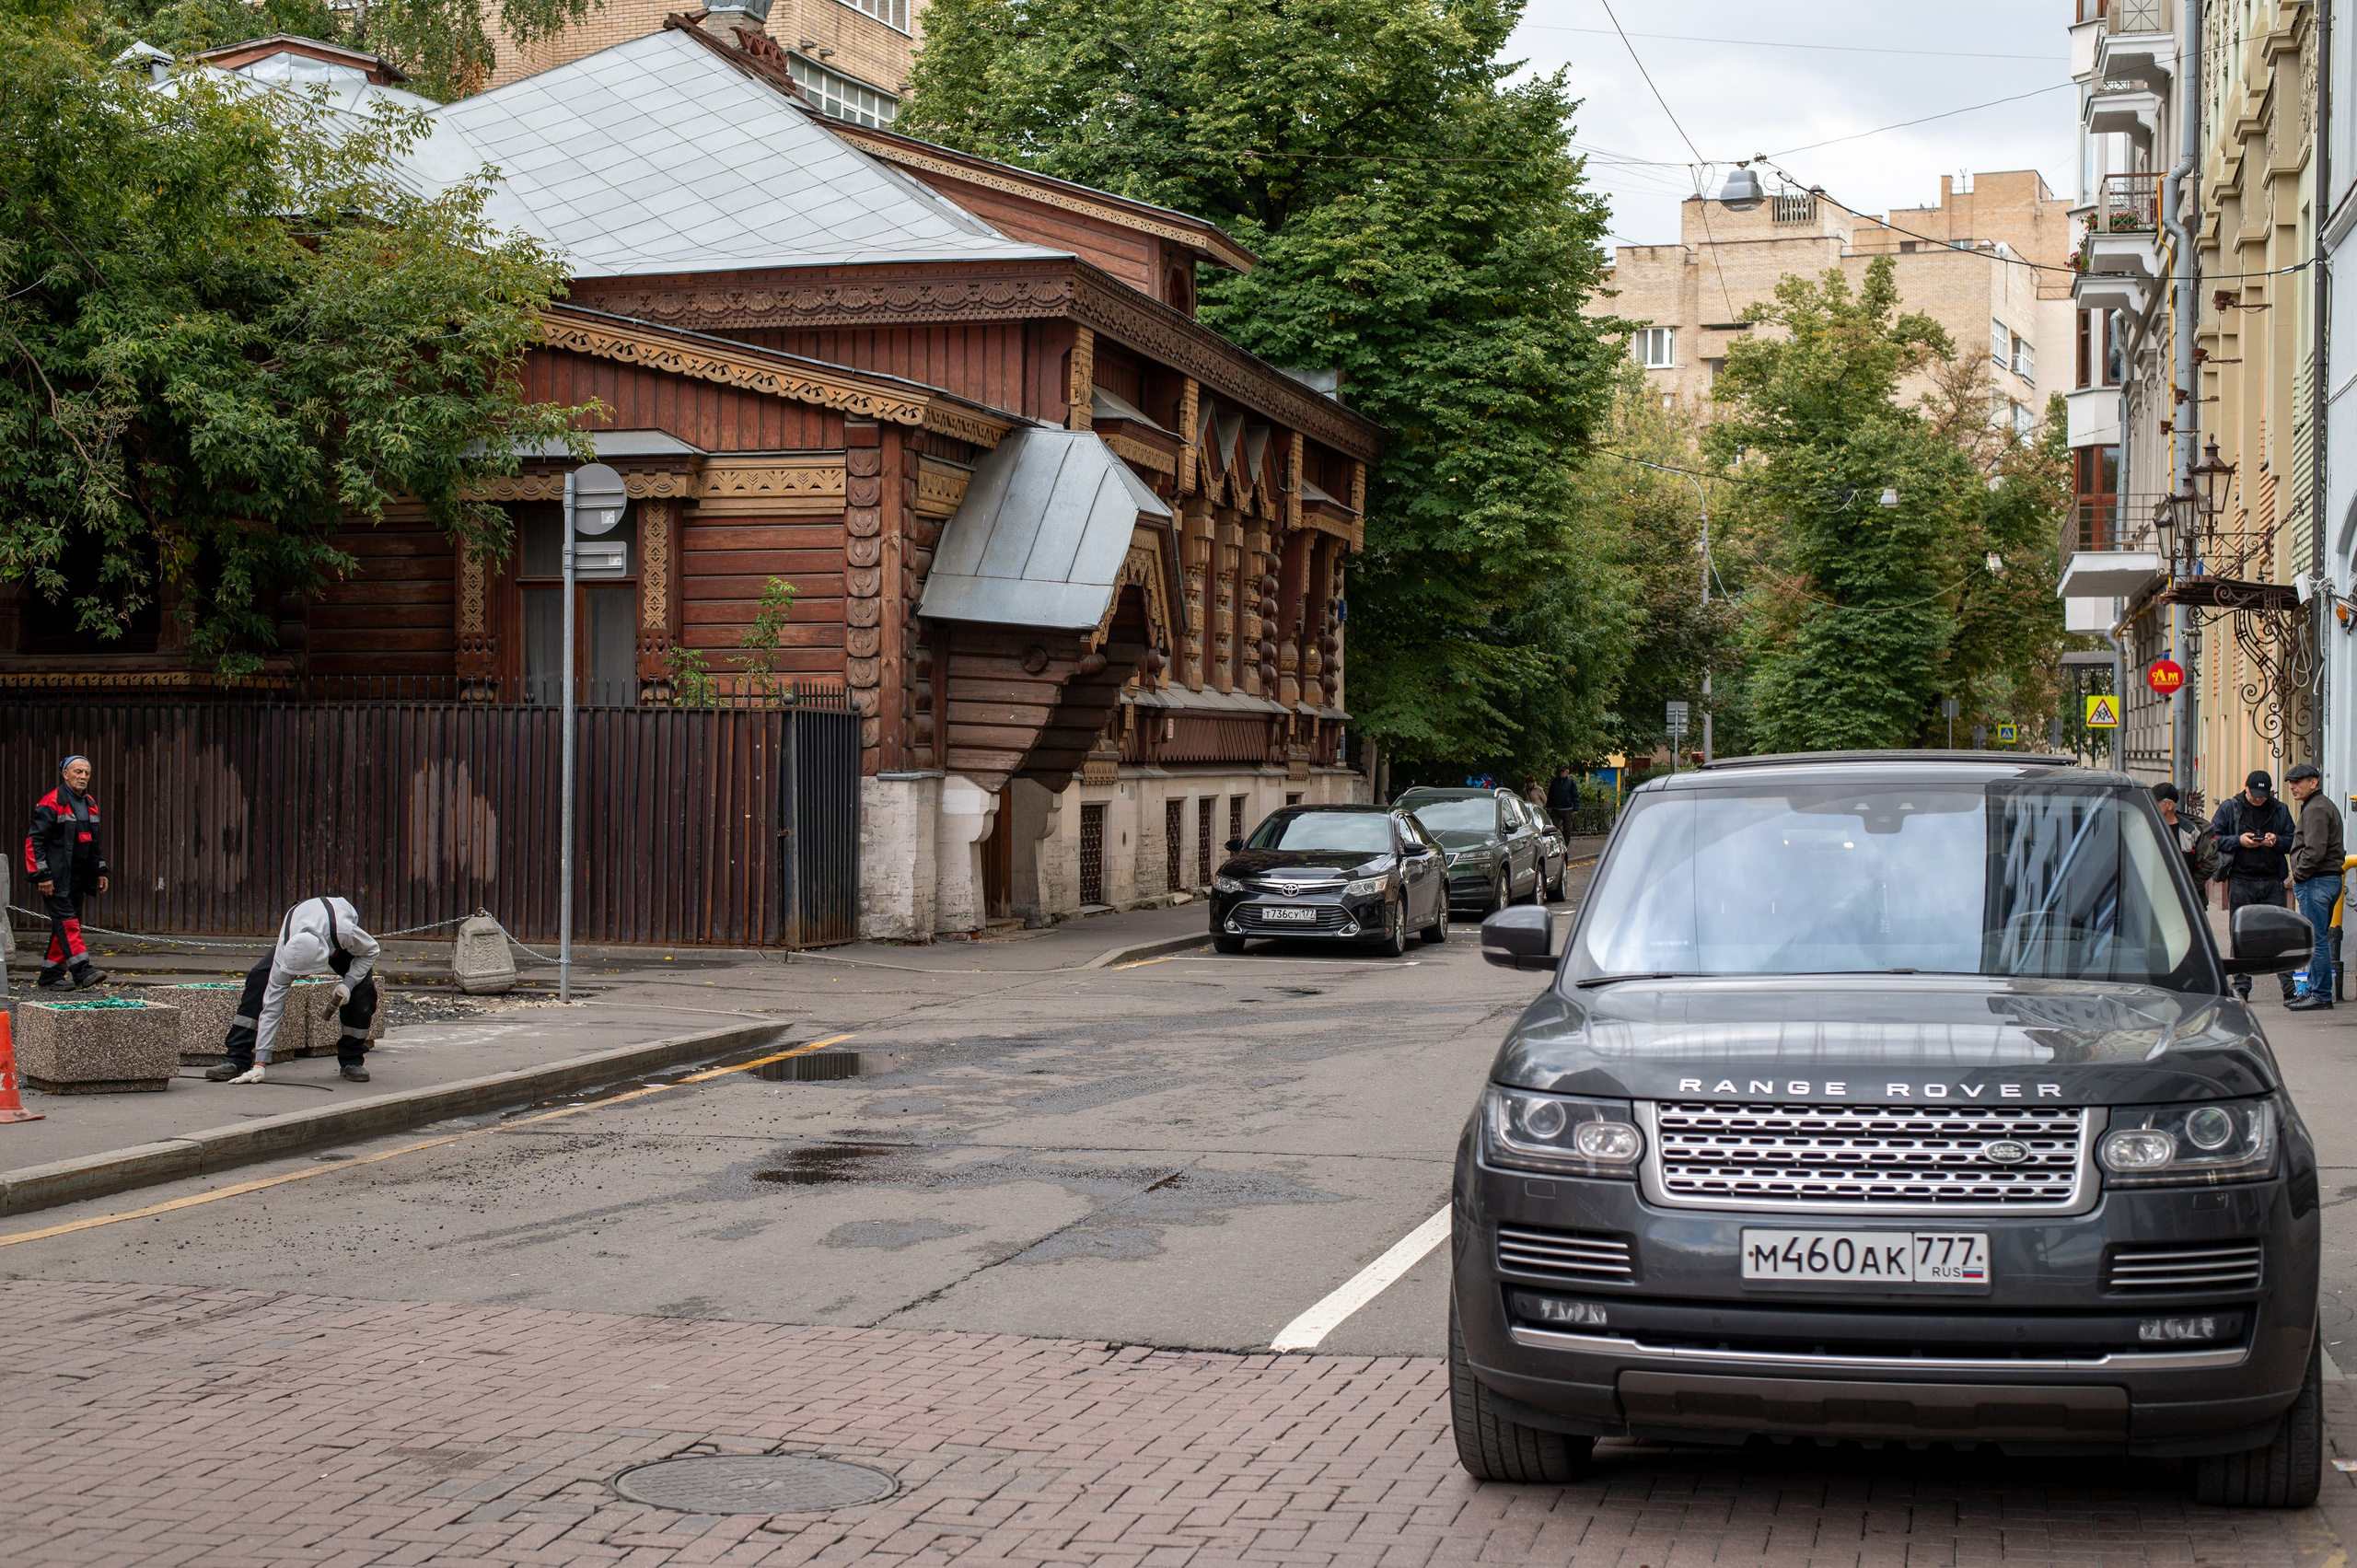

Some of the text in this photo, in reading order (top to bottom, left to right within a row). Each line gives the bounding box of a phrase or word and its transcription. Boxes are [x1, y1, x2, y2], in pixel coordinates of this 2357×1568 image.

[1266, 910, 1299, 919] Т736СУ
[1678, 1078, 2063, 1098] RANGE ROVER
[1754, 1237, 1975, 1275] М460АК 777
[1932, 1267, 1961, 1277] RUS
